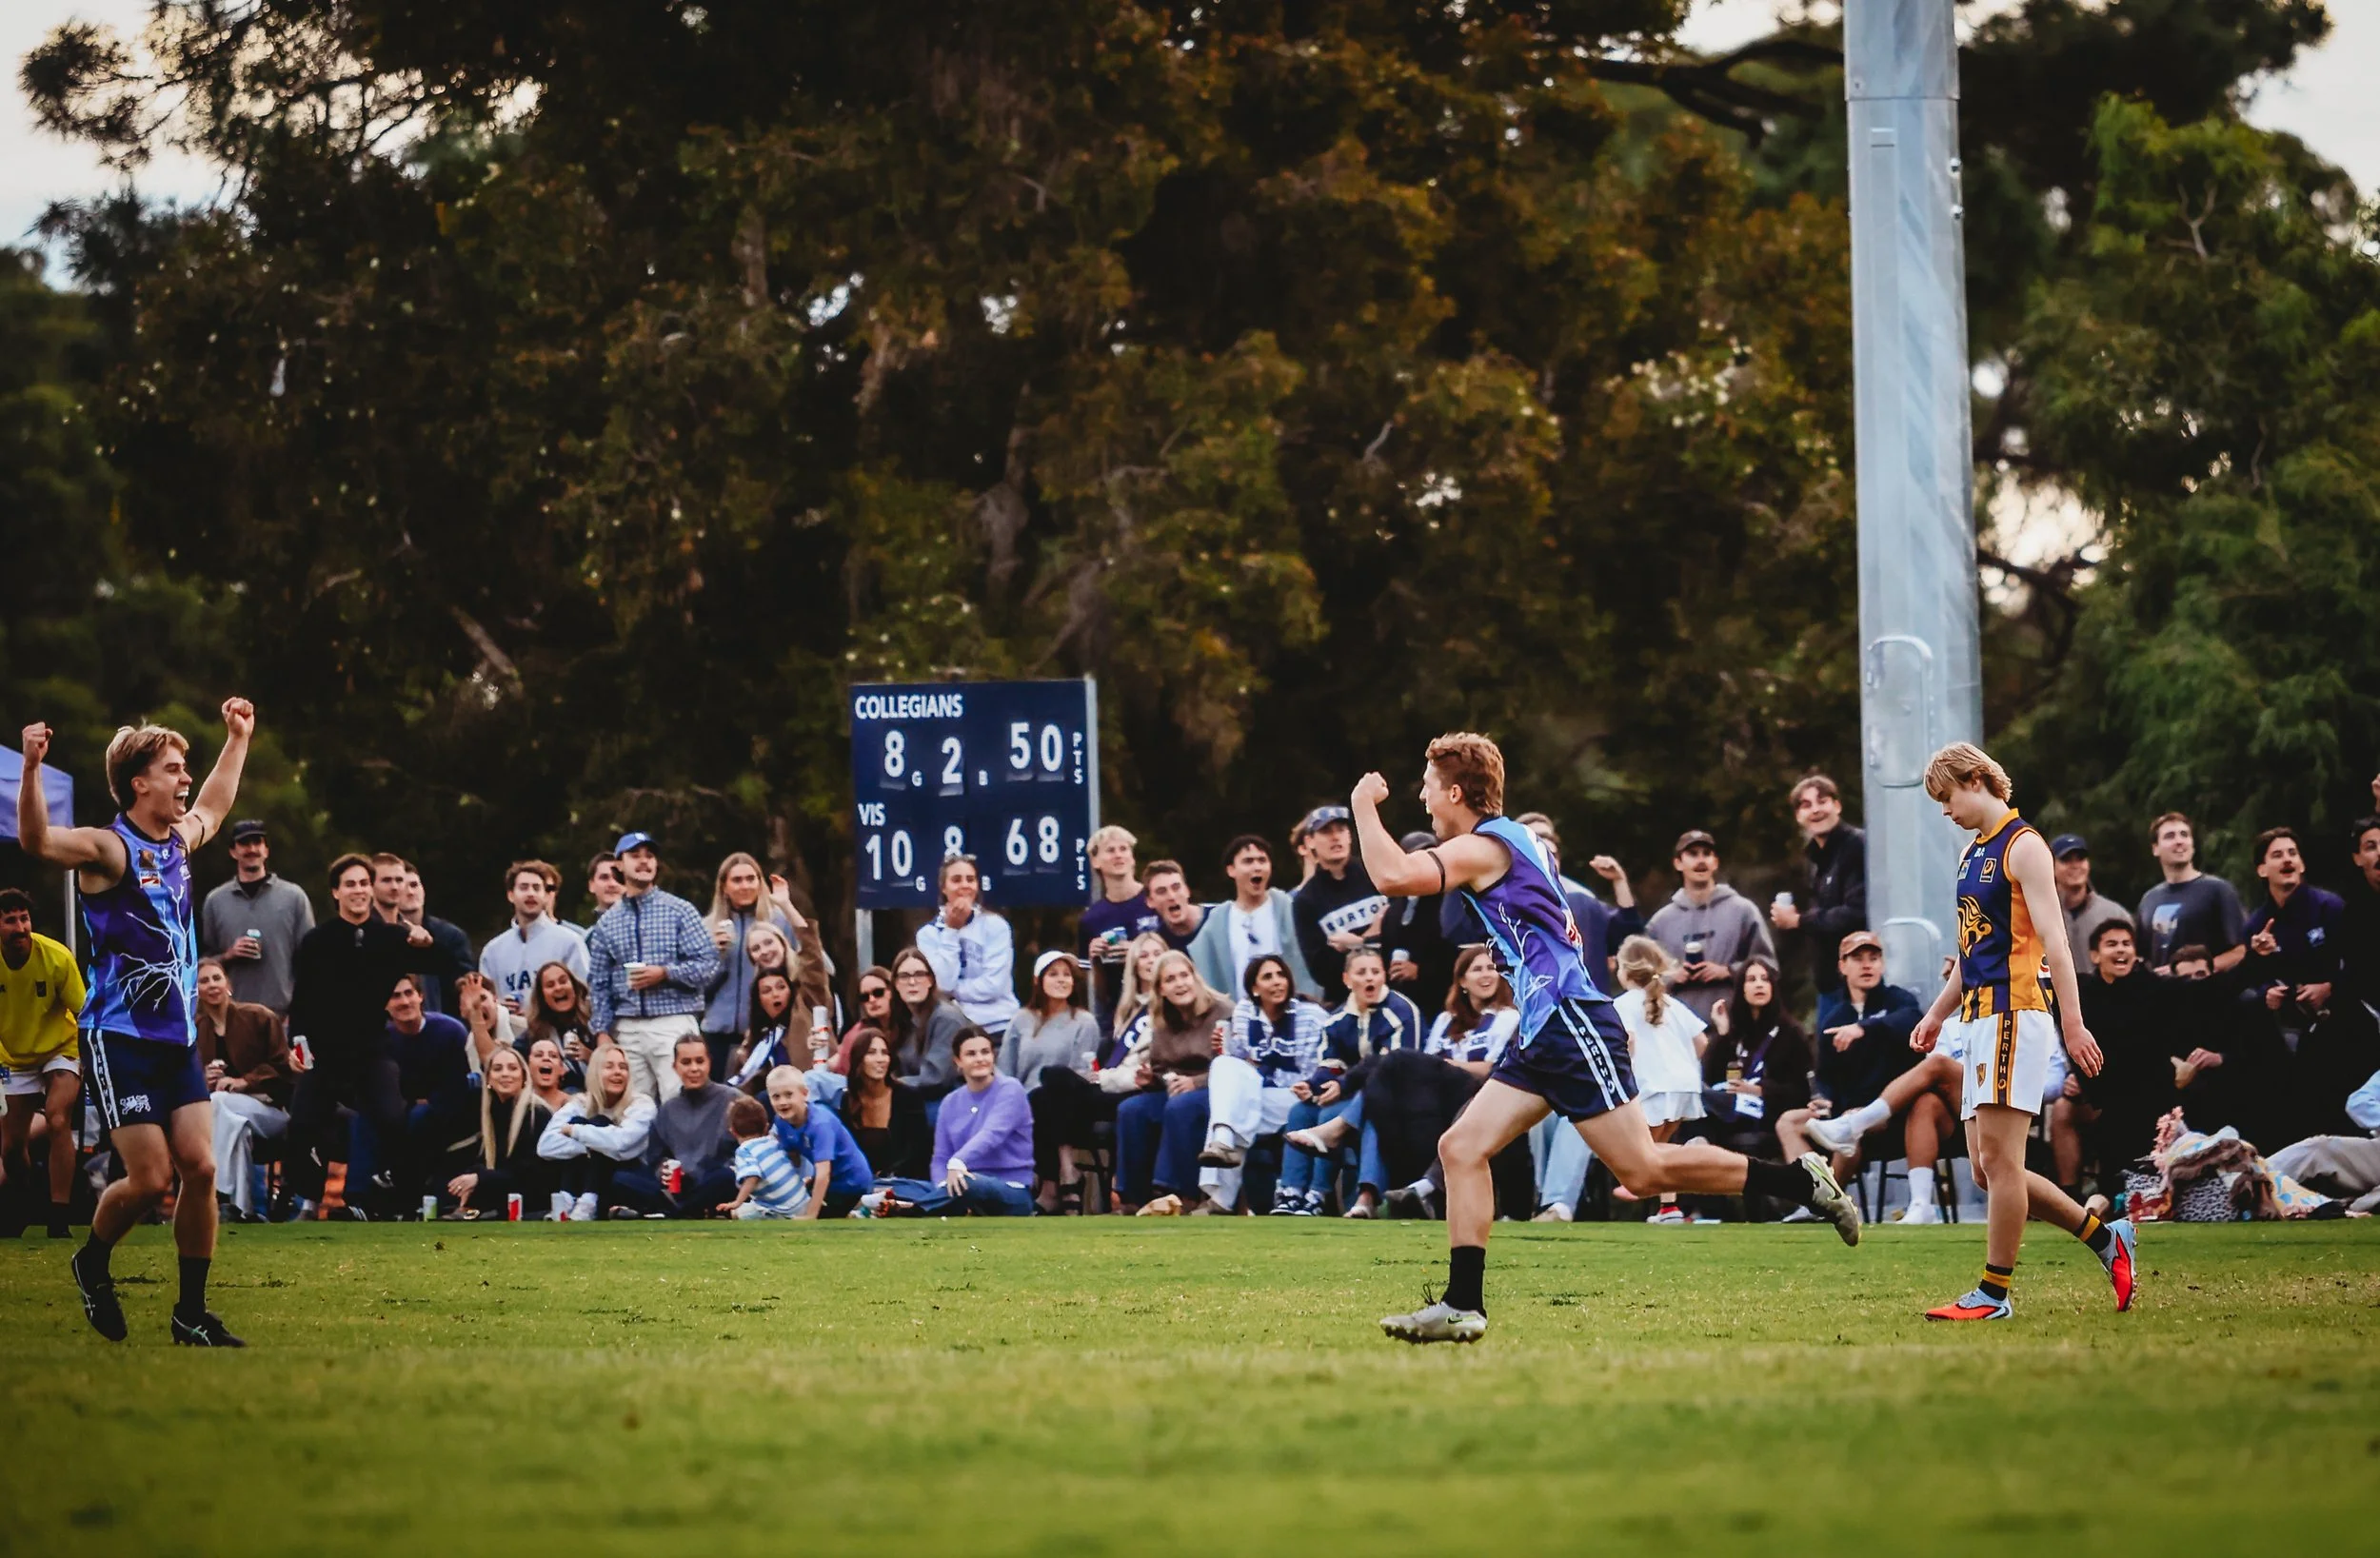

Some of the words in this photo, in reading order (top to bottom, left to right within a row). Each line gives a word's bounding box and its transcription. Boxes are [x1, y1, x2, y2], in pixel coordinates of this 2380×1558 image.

[855, 695, 963, 720] COLLEGIANS
[884, 730, 904, 778] 8
[912, 771, 922, 787] G
[942, 737, 962, 784] 2
[978, 770, 988, 786] B
[1009, 721, 1063, 772] 50
[1072, 732, 1083, 785] PTS
[858, 802, 885, 826] VIS
[865, 830, 913, 880] 10
[915, 876, 926, 892] G
[982, 876, 991, 892] B
[1005, 816, 1060, 865] 68
[1076, 838, 1086, 891] PTS
[1326, 901, 1387, 933] BURTO
[1578, 1026, 1609, 1077] PERTH
[2000, 1019, 2012, 1075] PERTH
